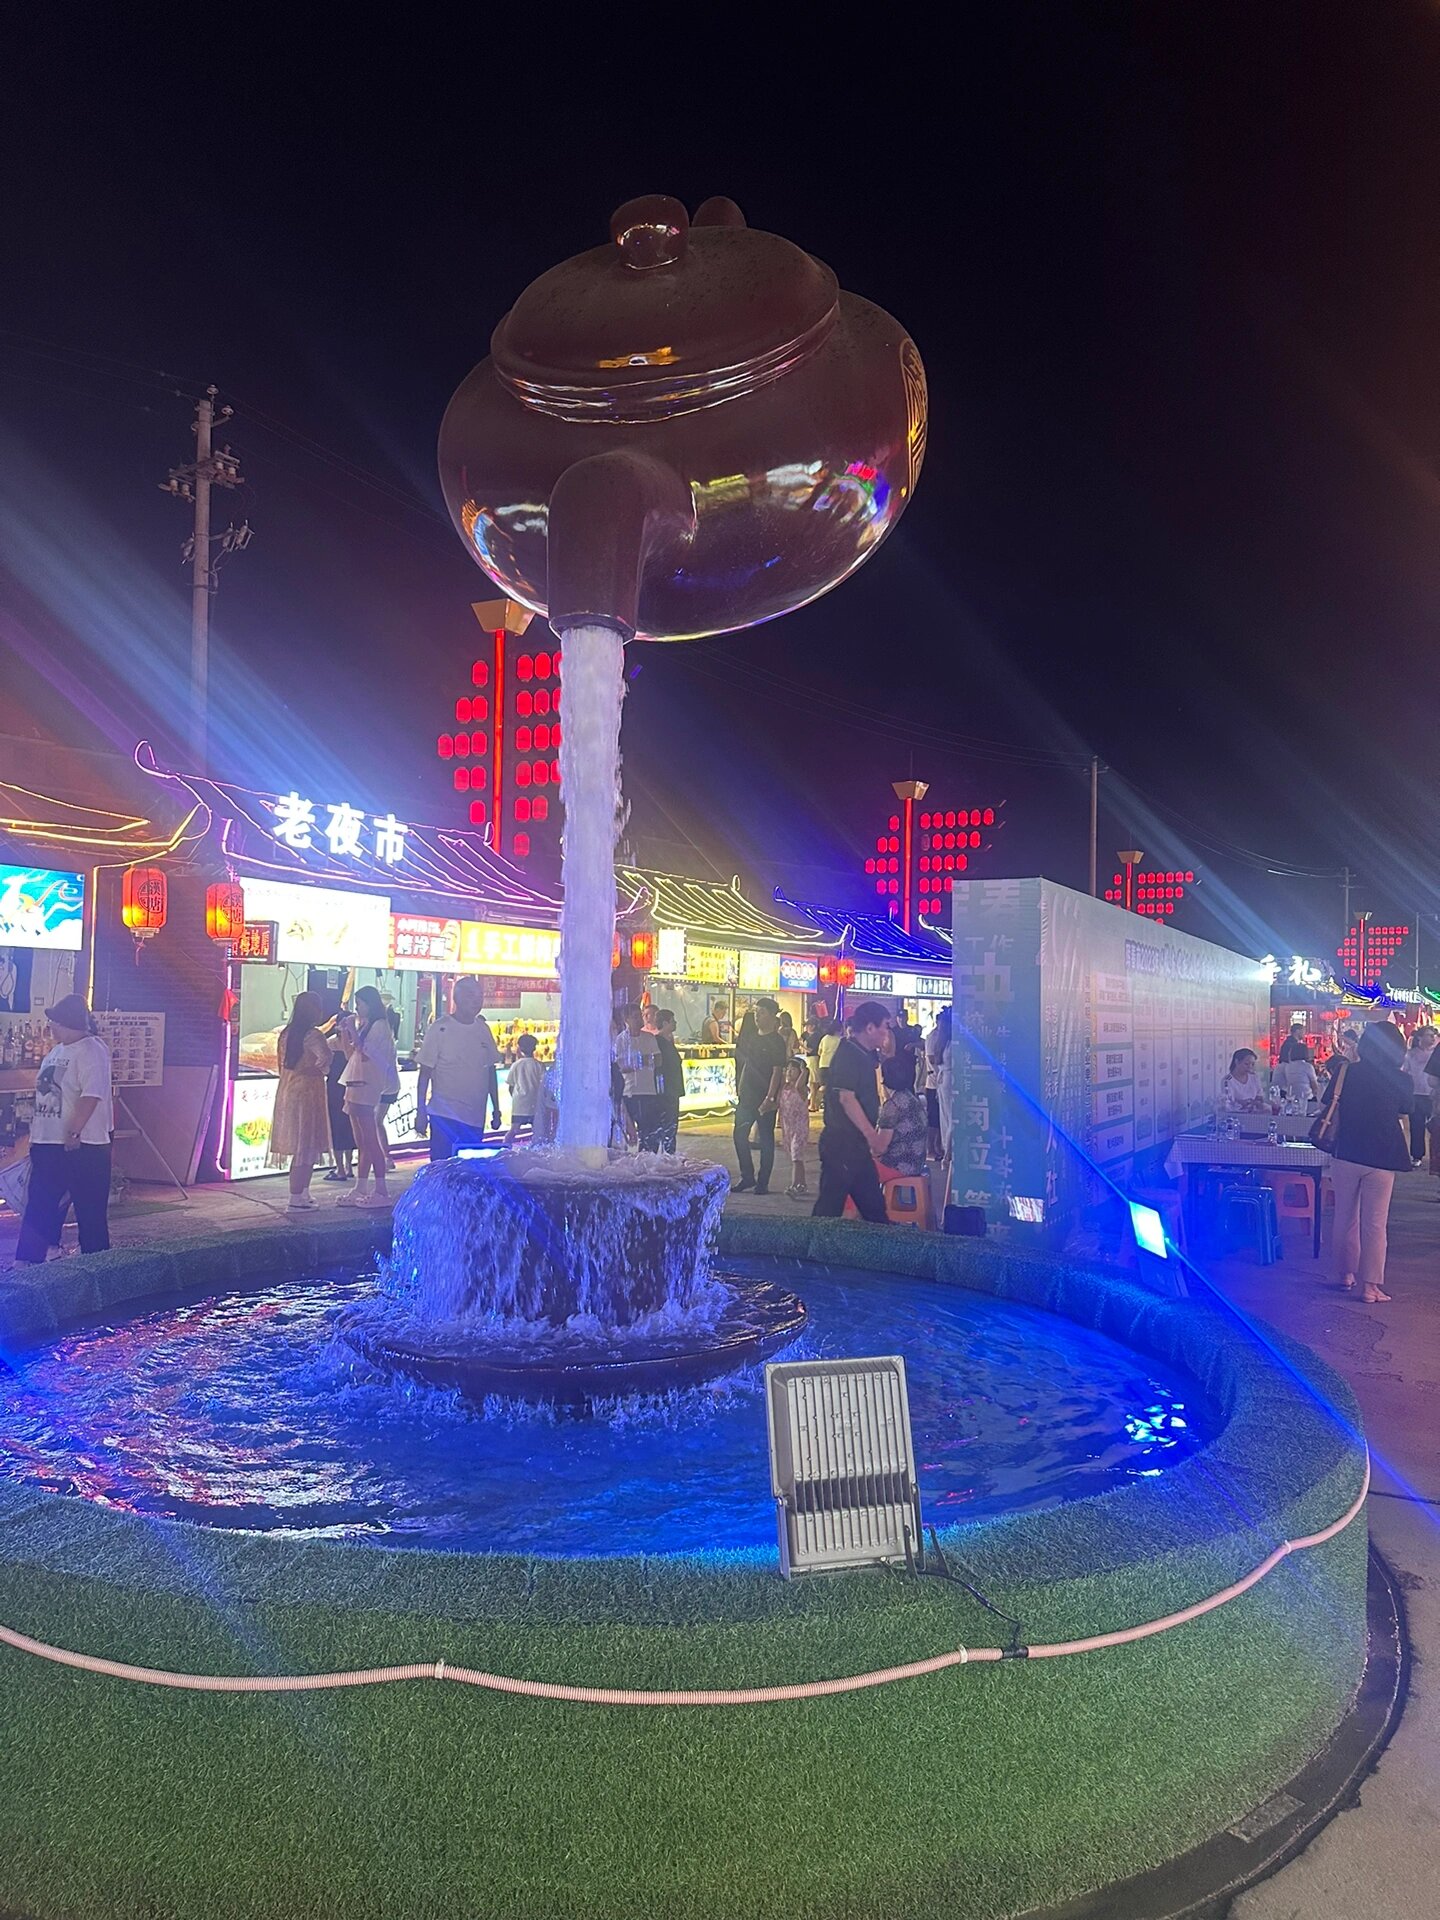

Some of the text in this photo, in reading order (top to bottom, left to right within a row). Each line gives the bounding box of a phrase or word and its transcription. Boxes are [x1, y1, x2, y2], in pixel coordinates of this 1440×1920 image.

[273, 790, 409, 865] 老夜市
[395, 933, 445, 958] 烤冷面
